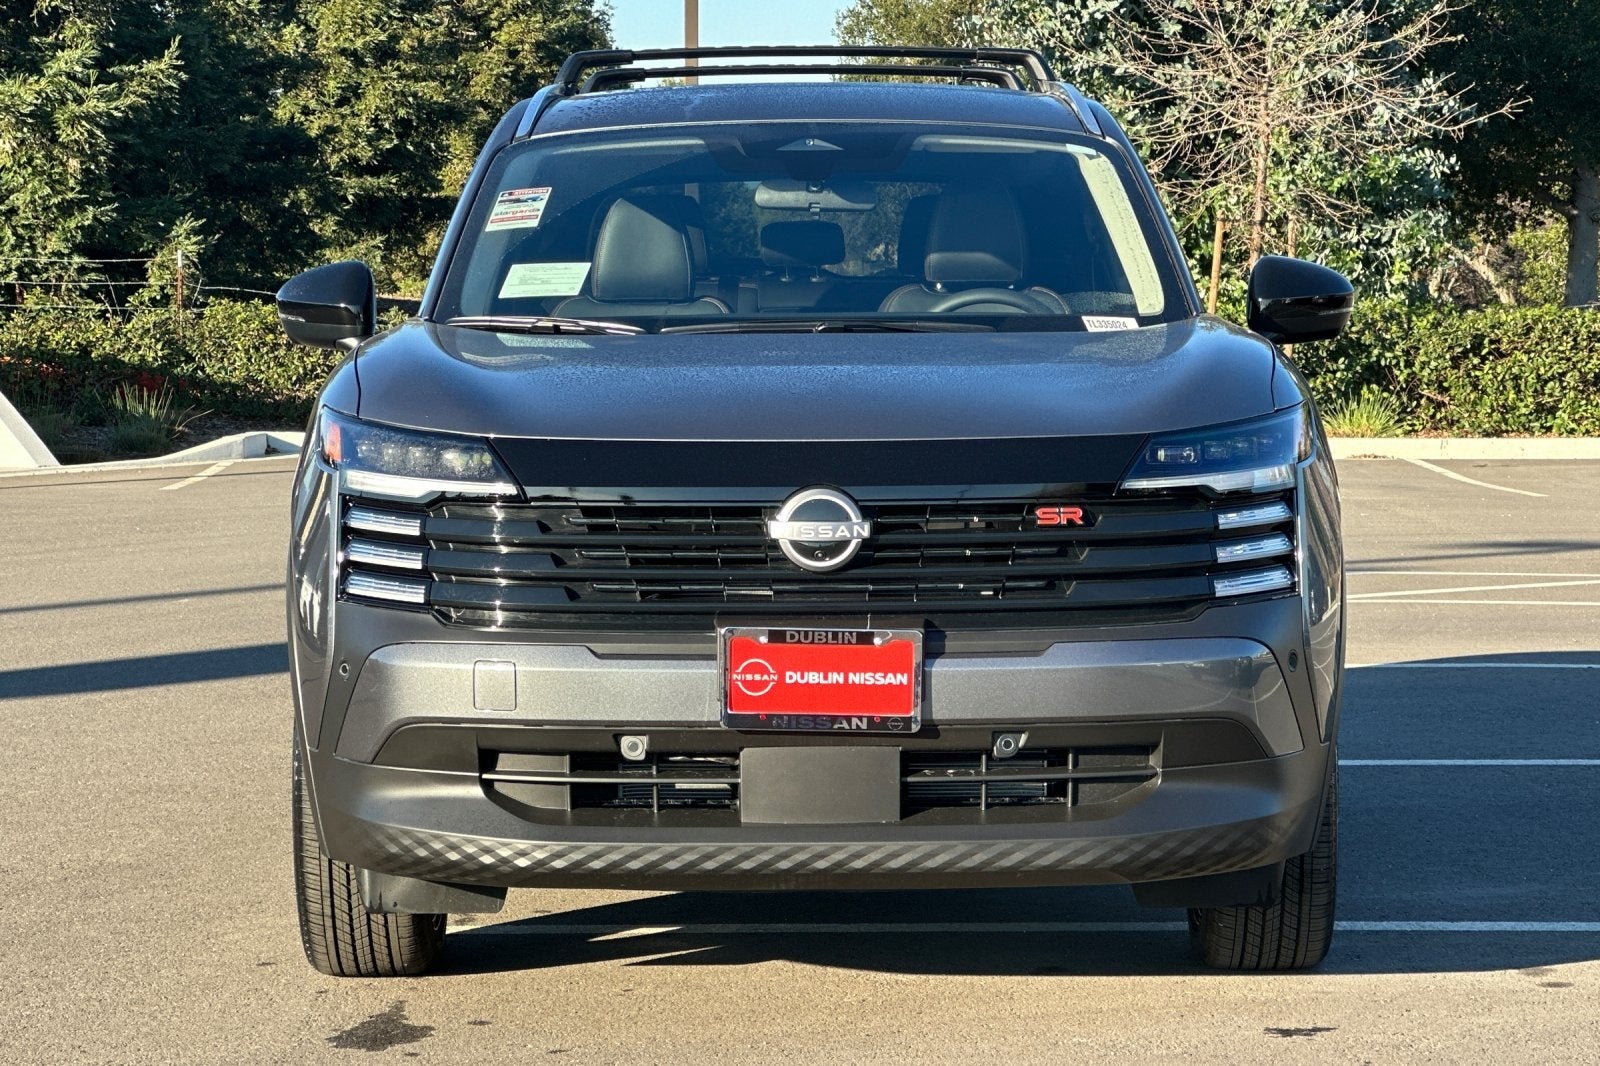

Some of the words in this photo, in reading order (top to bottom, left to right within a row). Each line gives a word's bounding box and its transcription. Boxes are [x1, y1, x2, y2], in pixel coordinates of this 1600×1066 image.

[1086, 320, 1128, 329] TL335024
[1035, 507, 1084, 525] SR
[775, 523, 869, 538] ISSAN
[785, 630, 857, 644] DUBLIN
[733, 673, 778, 681] NISSAN
[785, 671, 844, 685] DUBLIN
[848, 672, 908, 686] NISSAN
